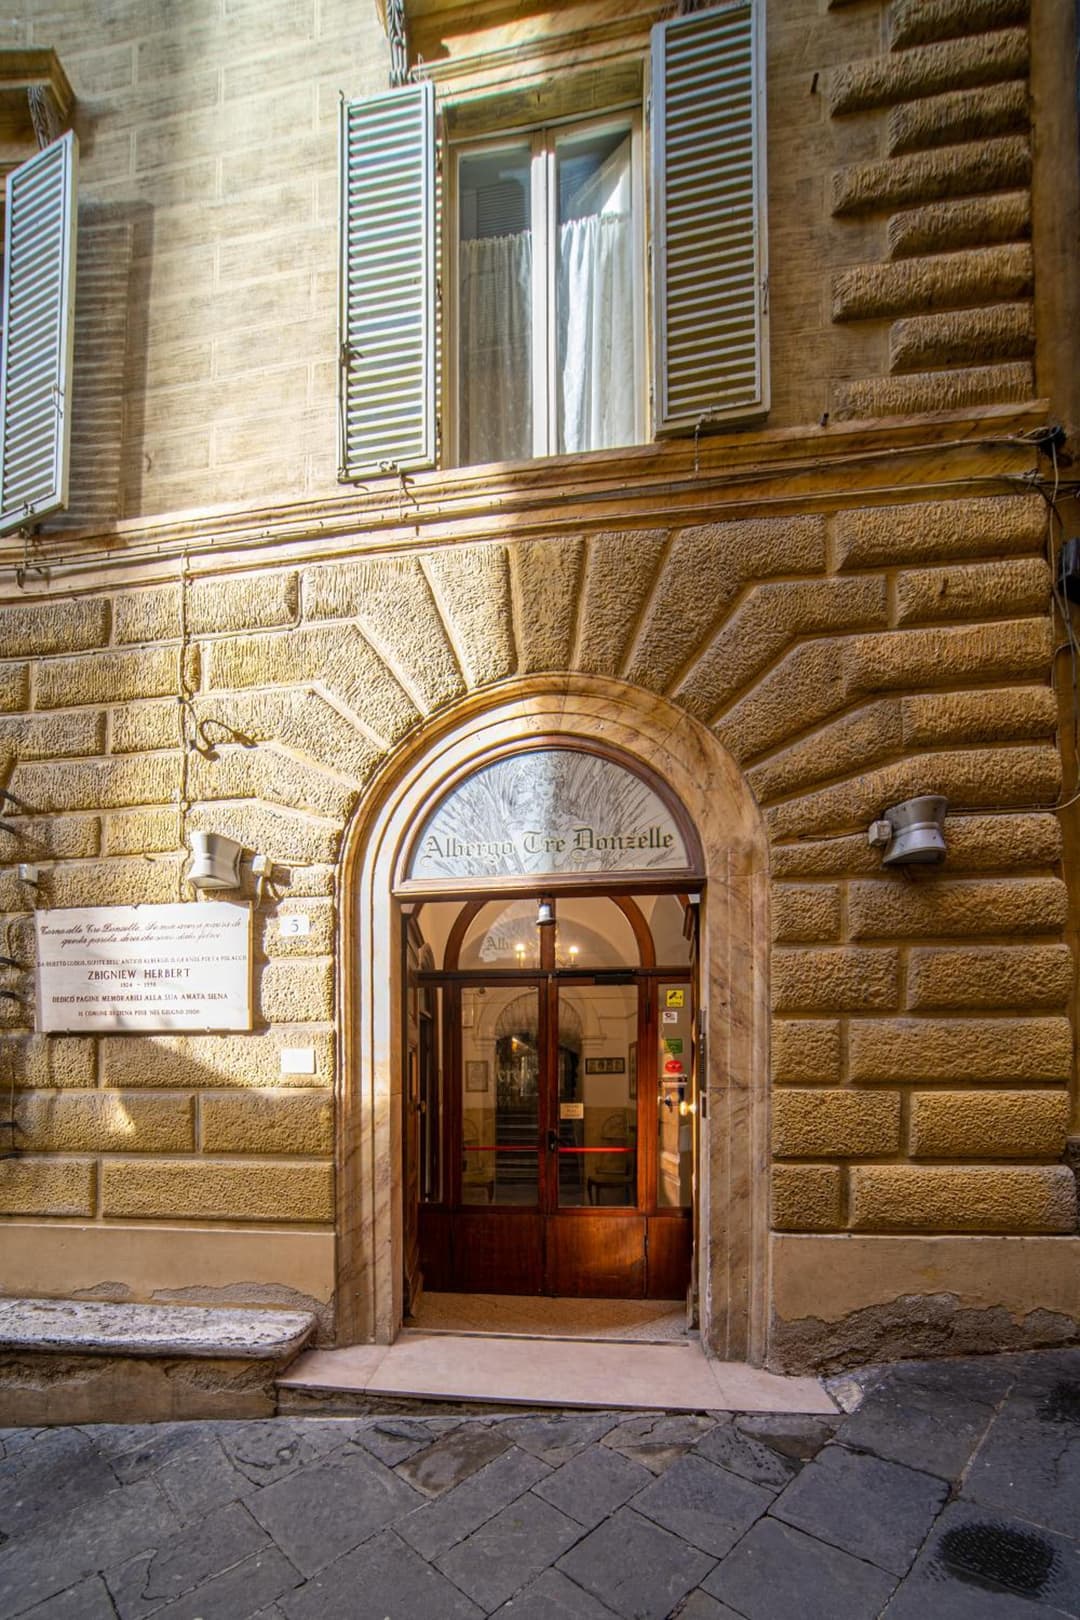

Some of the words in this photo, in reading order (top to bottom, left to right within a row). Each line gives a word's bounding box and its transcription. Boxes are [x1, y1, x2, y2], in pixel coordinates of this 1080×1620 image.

[424, 835, 513, 863] Albergo
[522, 831, 566, 854] Tre
[571, 825, 674, 852] Donzelle
[290, 918, 300, 934] 5
[87, 969, 137, 981] ZBIGNIEW
[143, 967, 190, 979] HERBERT
[76, 995, 99, 1003] PAGINE
[101, 994, 142, 1002] MEMORABILI
[144, 993, 163, 1001] ALLA
[164, 993, 178, 1001] SUA
[180, 992, 206, 1001] AMATA
[207, 992, 229, 1000] SIENA
